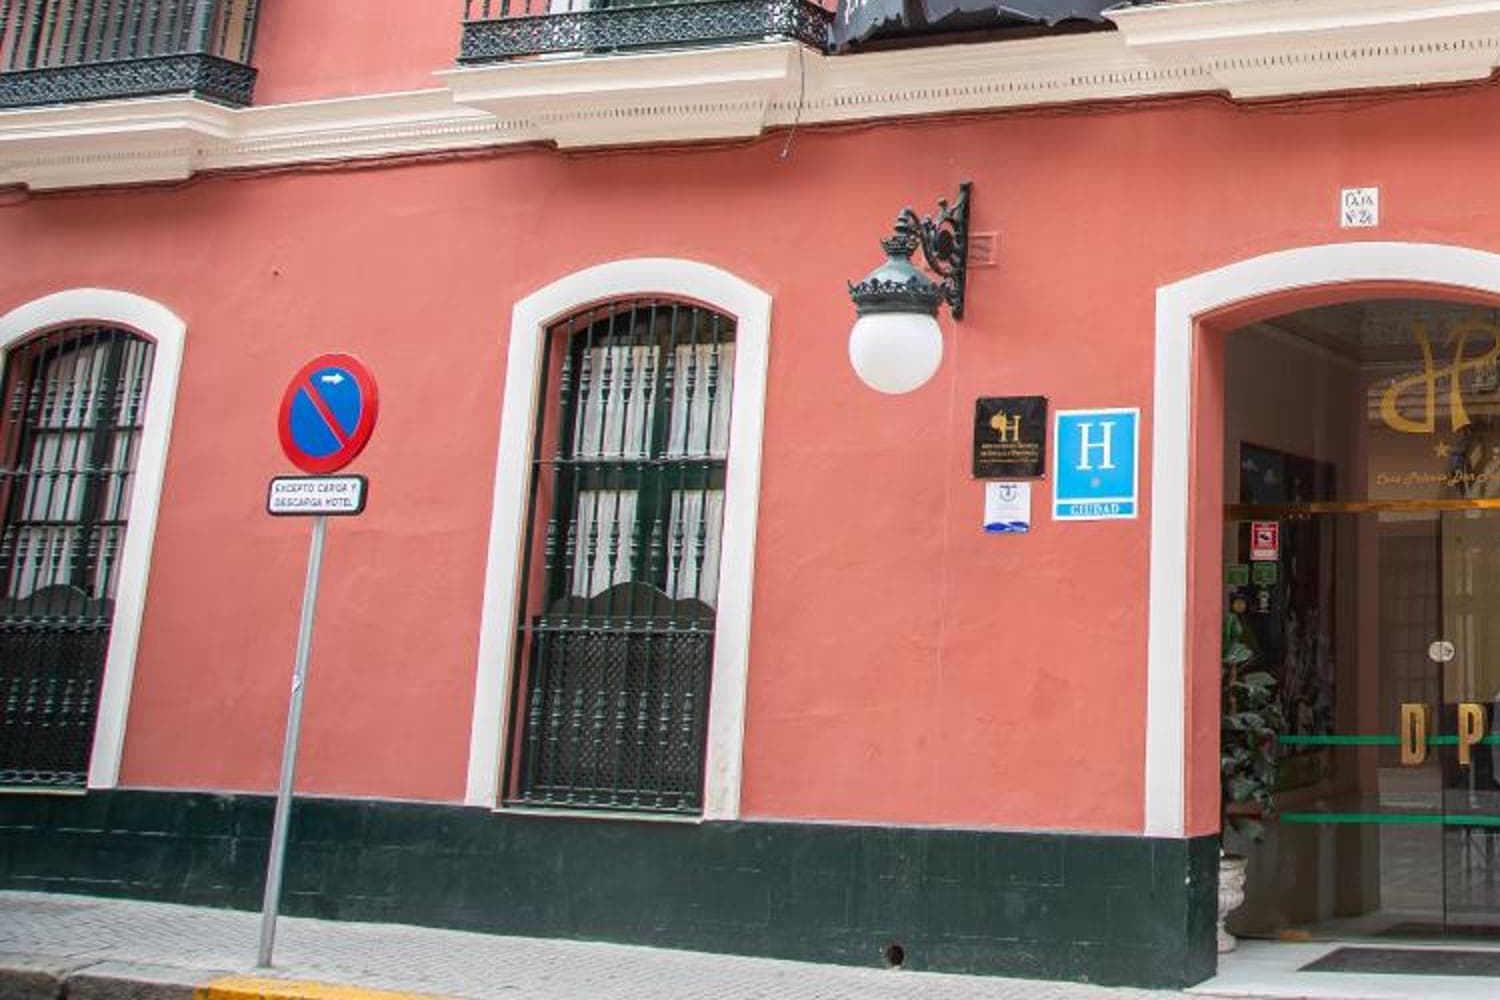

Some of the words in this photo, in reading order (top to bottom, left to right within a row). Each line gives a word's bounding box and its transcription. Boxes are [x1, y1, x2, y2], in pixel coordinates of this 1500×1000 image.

[1076, 421, 1117, 470] H
[1071, 503, 1120, 515] CIUDAD
[1401, 703, 1428, 765] D
[1458, 703, 1485, 765] P
